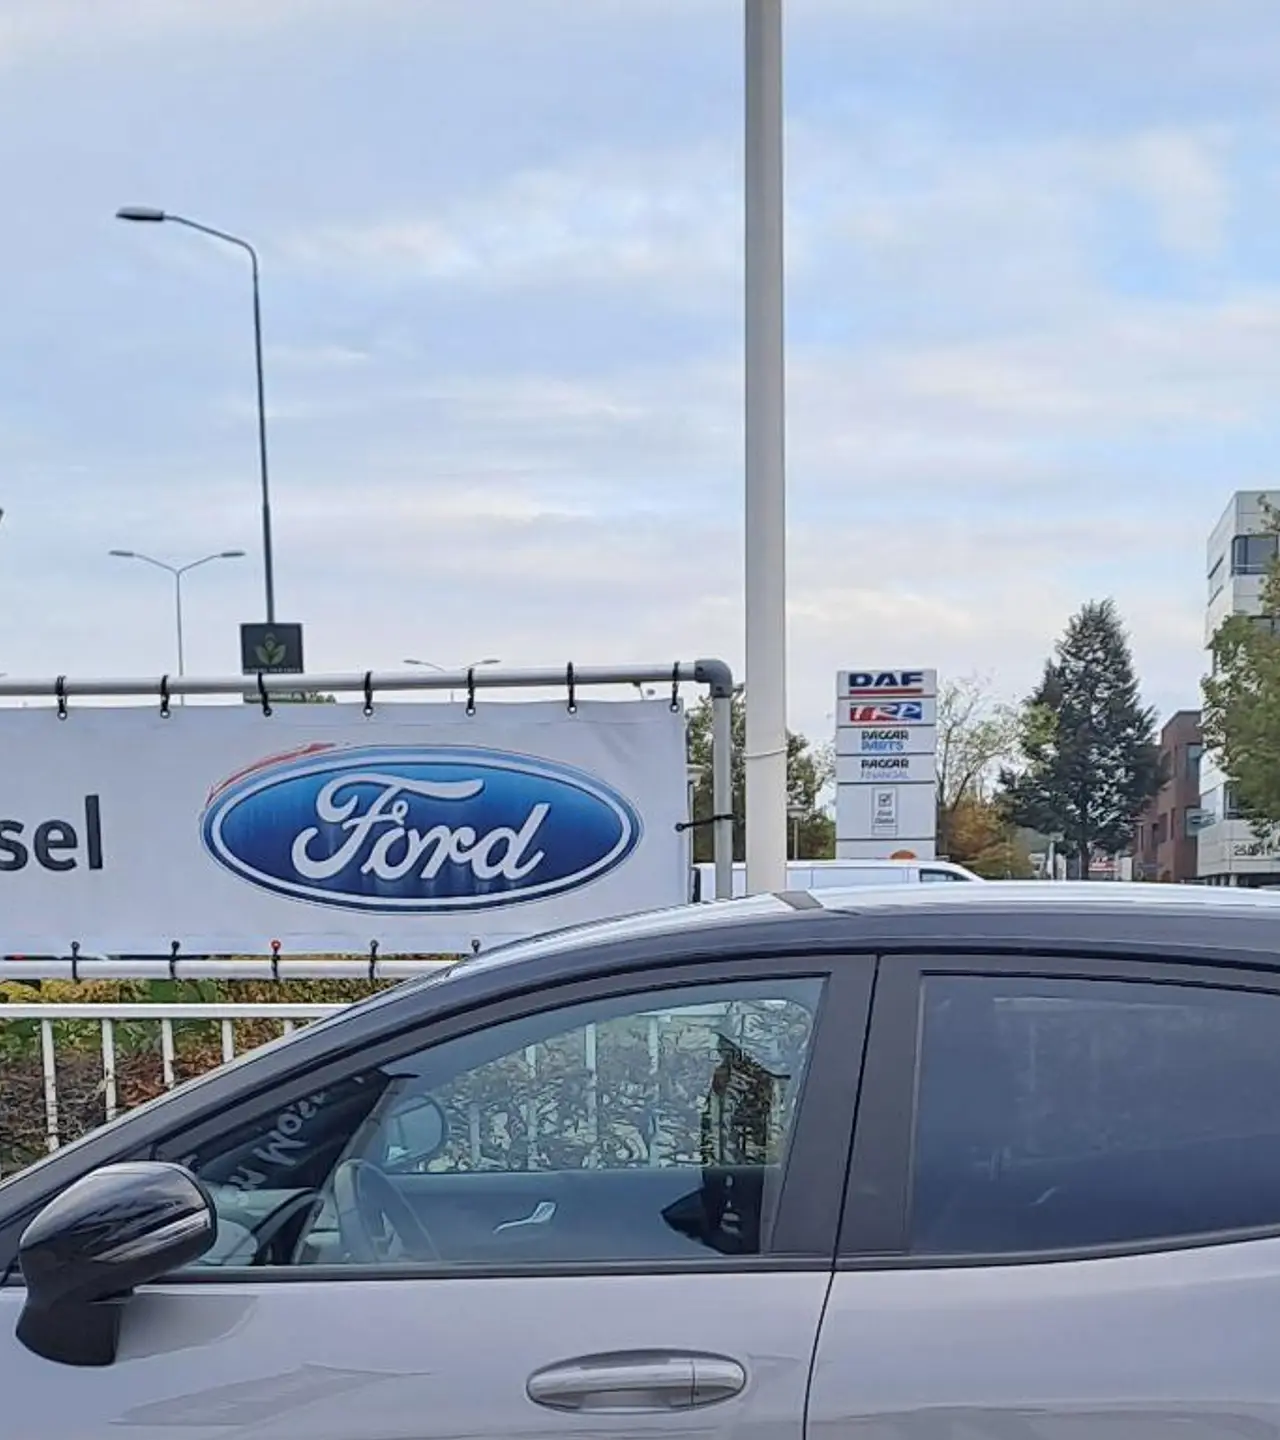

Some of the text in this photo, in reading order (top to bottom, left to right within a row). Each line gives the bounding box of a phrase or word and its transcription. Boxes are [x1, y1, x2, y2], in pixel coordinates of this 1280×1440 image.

[848, 672, 923, 687] DAF
[850, 702, 922, 721] TRP
[861, 730, 909, 740] PACCAR
[861, 758, 909, 768] PACCAR
[291, 772, 551, 879] Ford
